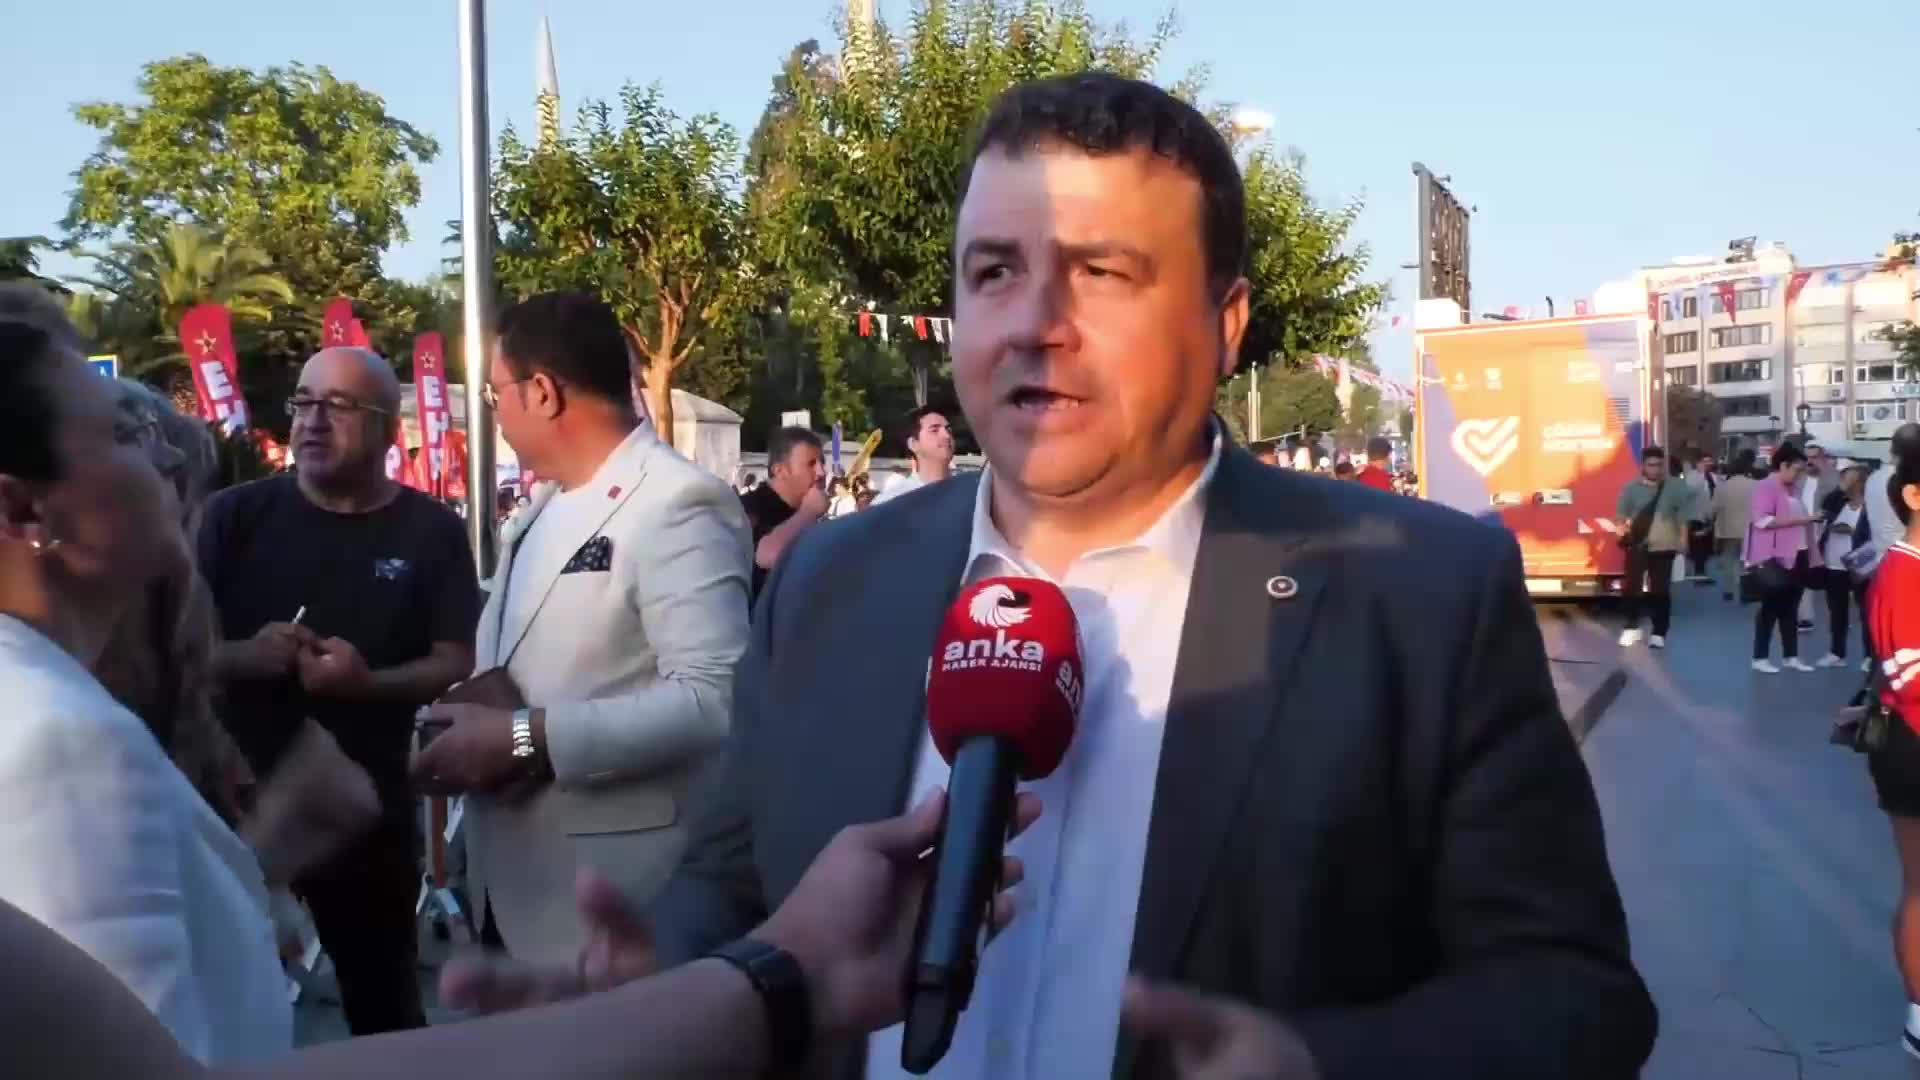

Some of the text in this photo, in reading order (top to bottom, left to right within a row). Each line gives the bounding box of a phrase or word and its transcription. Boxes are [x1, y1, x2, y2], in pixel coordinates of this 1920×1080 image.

[944, 628, 1044, 663] anka
[942, 659, 1042, 673] HABER AJANSI
